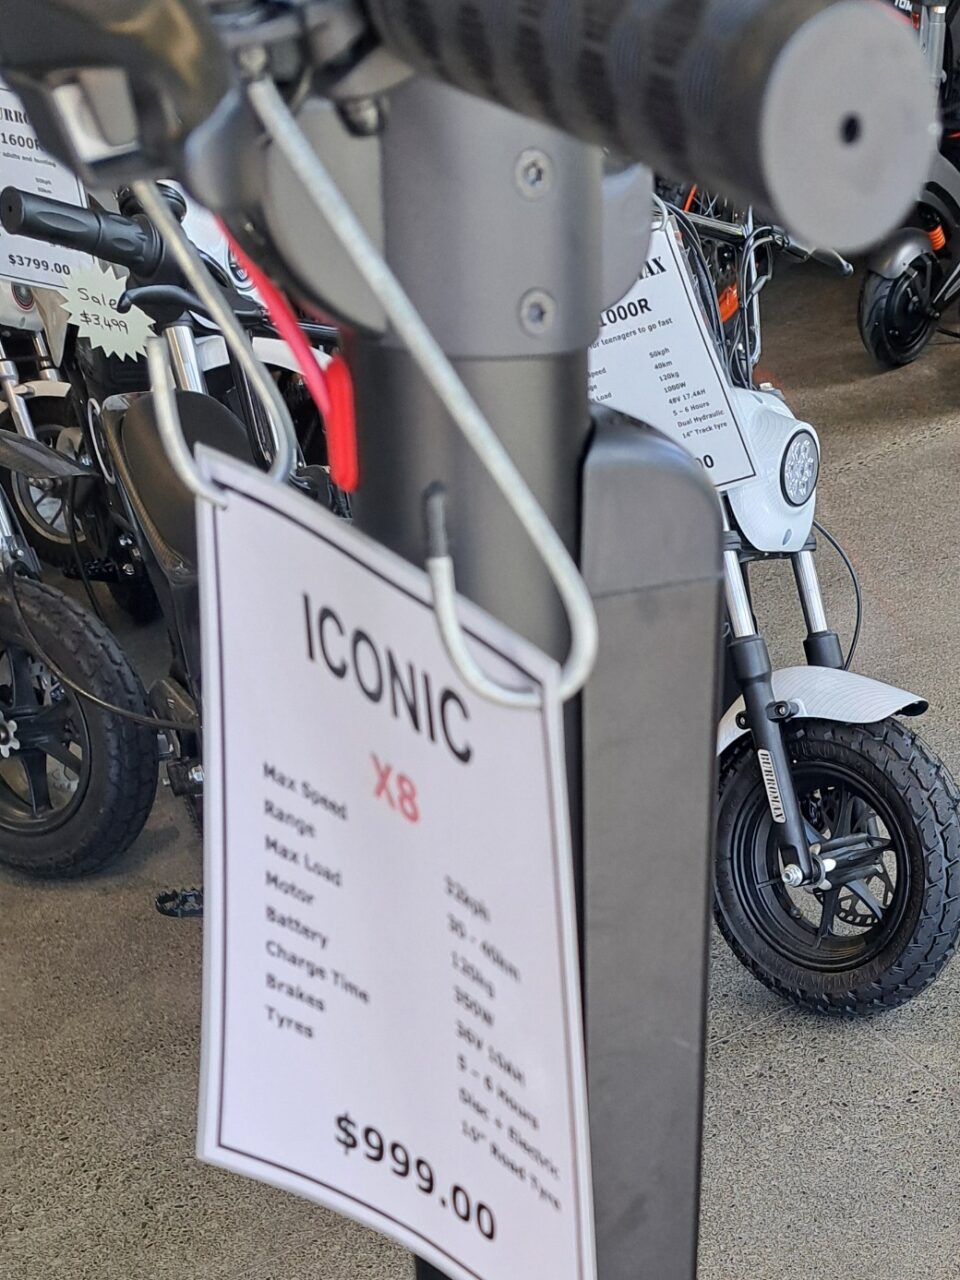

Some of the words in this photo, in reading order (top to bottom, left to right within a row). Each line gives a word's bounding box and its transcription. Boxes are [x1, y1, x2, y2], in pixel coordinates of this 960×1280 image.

[8, 254, 71, 275] $3799.00
[77, 287, 118, 310] Sale
[600, 329, 637, 345] teenagers
[637, 326, 646, 334] to
[647, 323, 657, 332] go
[658, 317, 673, 328] fast
[649, 347, 670, 358] 50kph
[654, 360, 673, 370] 40km
[658, 371, 680, 382] 120kg
[664, 381, 687, 393] 1000W
[677, 418, 692, 428] Dual
[693, 409, 725, 423] Hydraulic
[690, 401, 710, 411] Hours
[694, 425, 713, 436] Track
[303, 593, 472, 764] ICONIC
[263, 761, 297, 792] Max
[301, 781, 348, 821] Speed
[371, 752, 419, 822] X8
[264, 798, 316, 838] Range
[265, 834, 299, 864] Max
[304, 852, 343, 887] Load
[266, 870, 316, 904] Motor
[266, 905, 328, 949] Battery
[265, 939, 327, 980] Charge
[332, 968, 369, 1004] Time
[266, 972, 325, 1011] Brakes
[265, 1004, 314, 1038] Tyres
[336, 1112, 495, 1240] $999.00
